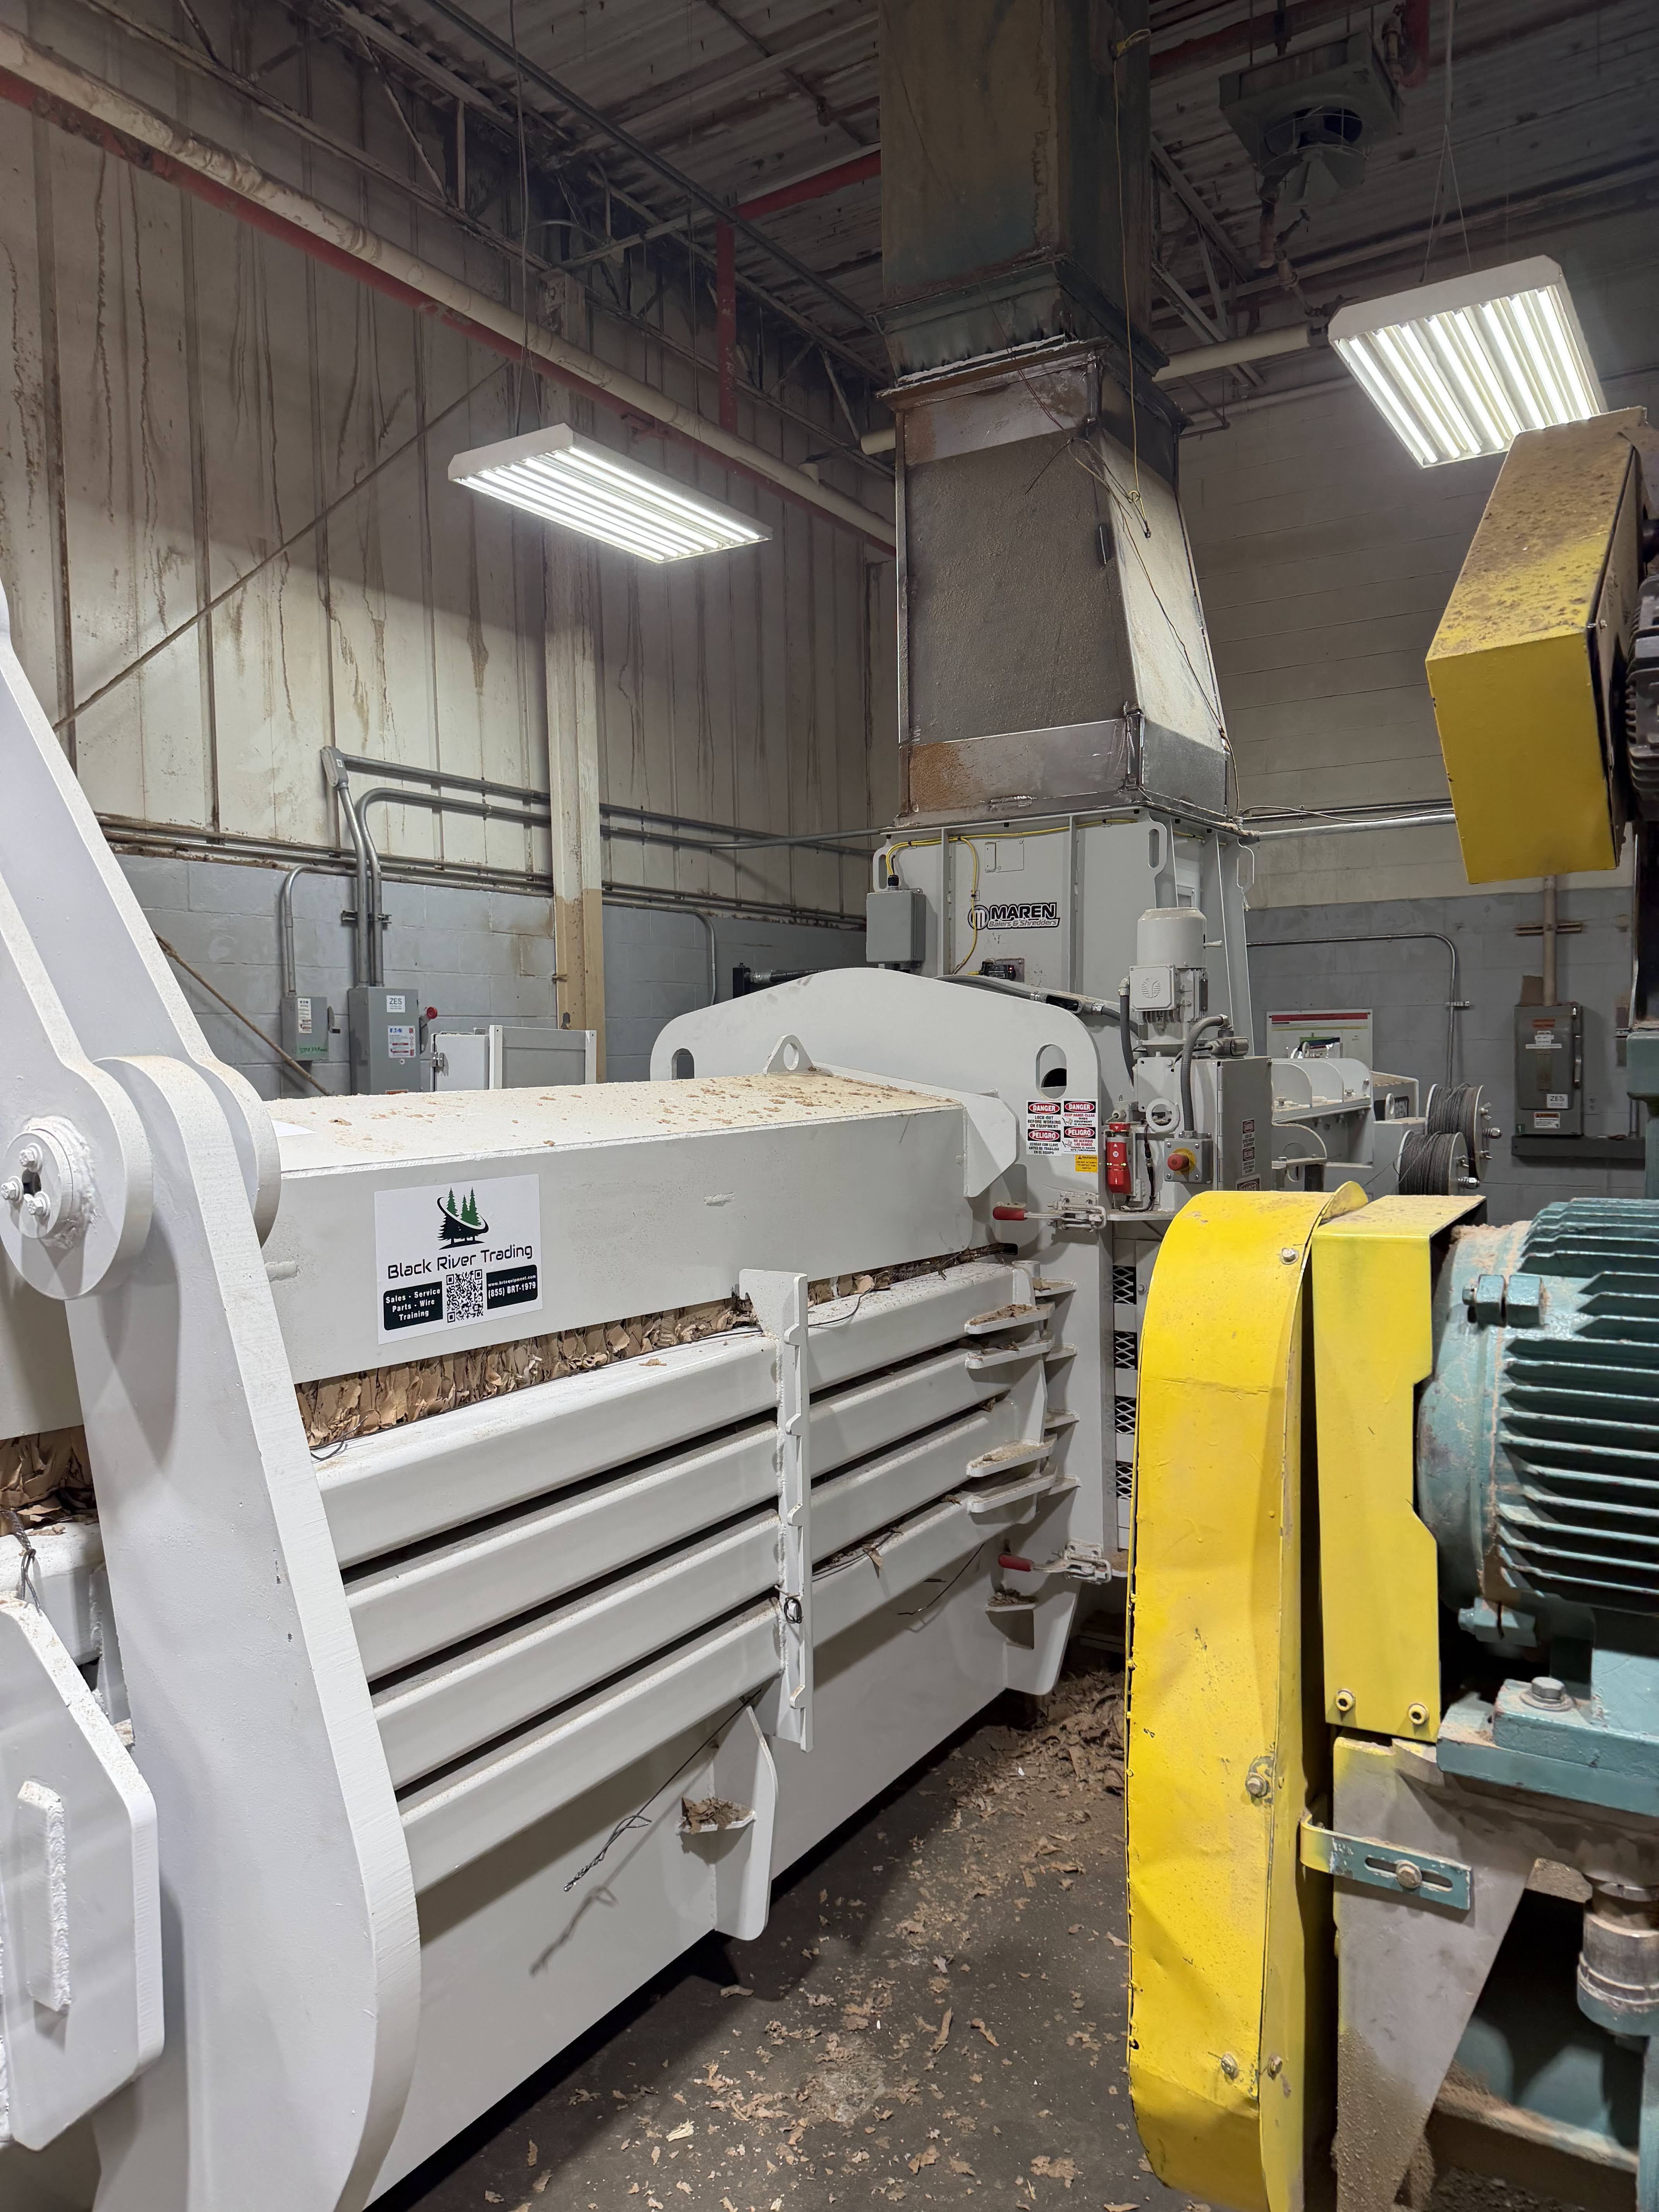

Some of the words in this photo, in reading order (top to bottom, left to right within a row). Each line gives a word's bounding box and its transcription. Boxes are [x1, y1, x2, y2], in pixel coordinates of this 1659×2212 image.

[990, 904, 1055, 919] MAREN
[388, 1259, 432, 1279] Black
[437, 1254, 476, 1271] River
[481, 1244, 532, 1263] Trading
[488, 1275, 536, 1287] www.brtequipment.com
[386, 1295, 406, 1304] Sales
[414, 1289, 440, 1298] Service
[488, 1287, 505, 1299] (855)
[507, 1281, 536, 1294] BRT-1979
[392, 1304, 411, 1312] Parts
[399, 1310, 429, 1321] Training
